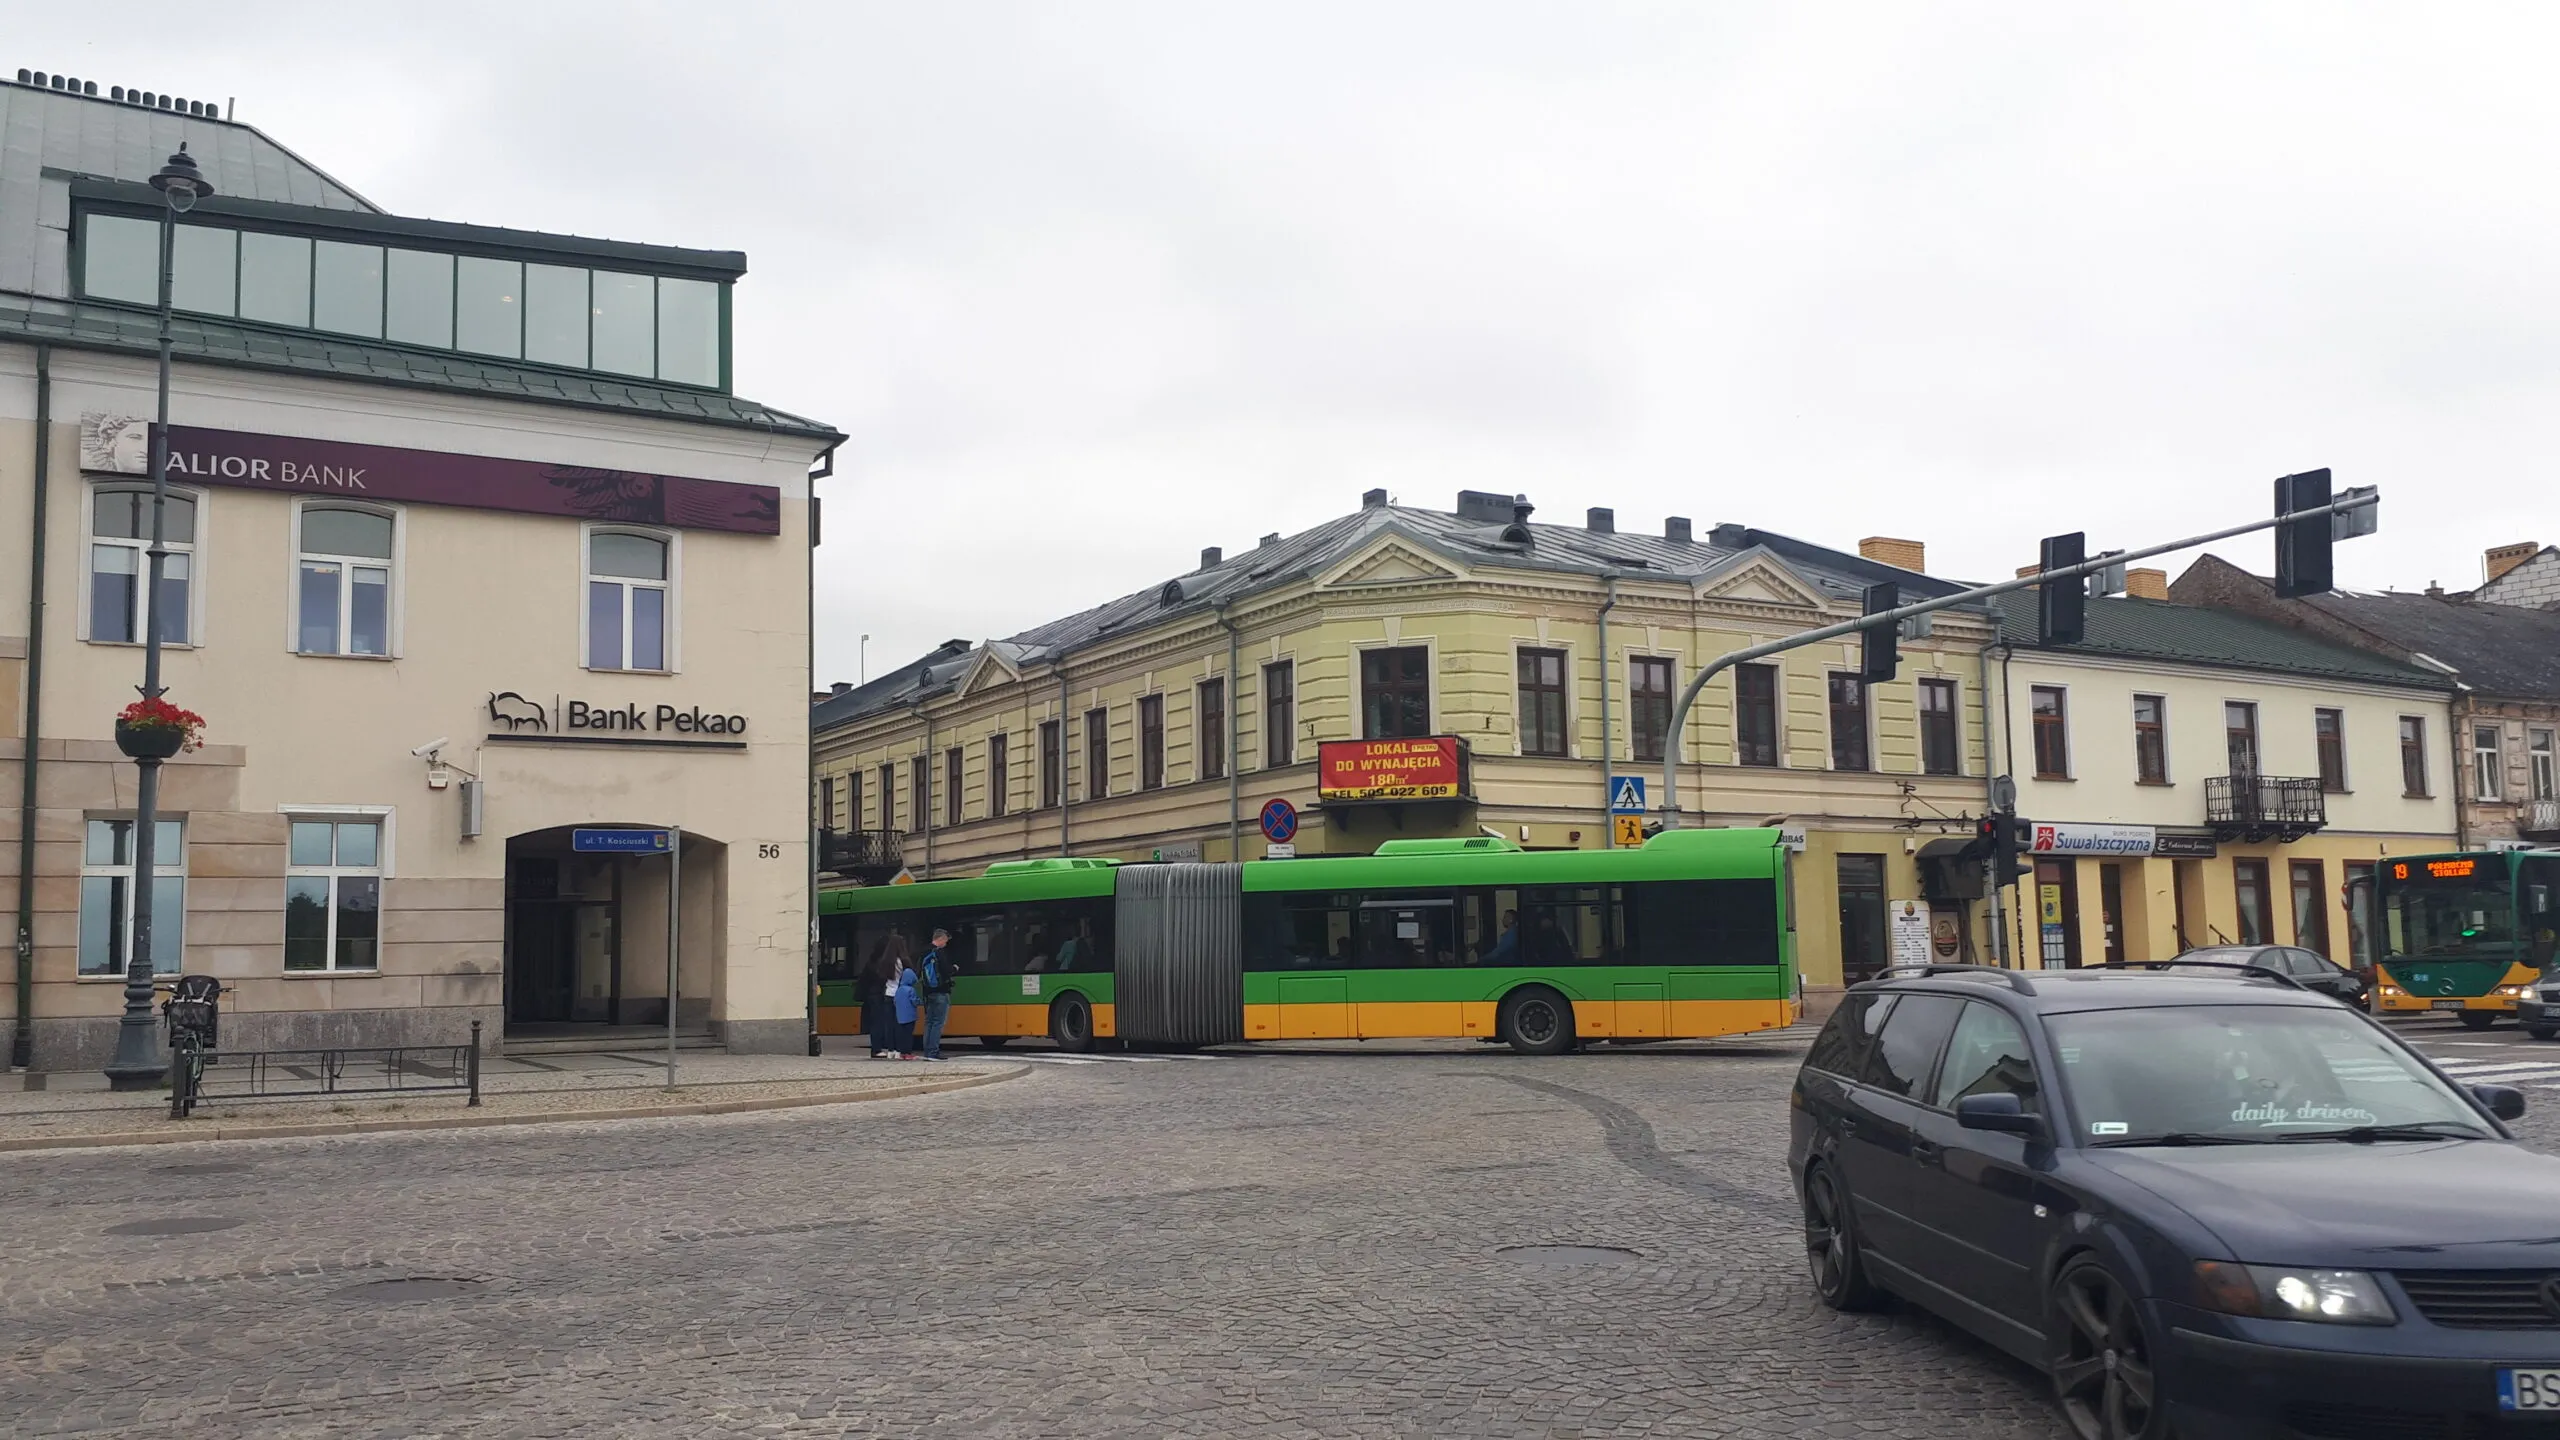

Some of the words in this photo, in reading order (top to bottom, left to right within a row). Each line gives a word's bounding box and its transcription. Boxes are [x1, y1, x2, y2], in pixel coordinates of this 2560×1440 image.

[165, 452, 272, 480] ALIOR
[281, 461, 368, 489] BANK
[568, 700, 647, 731] Bank
[656, 704, 747, 734] Pekao
[1366, 743, 1410, 755] LOKAL
[1335, 760, 1355, 772] DO
[1360, 756, 1441, 771] WYNAJĘCIA
[1390, 786, 1416, 797] 022
[1421, 785, 1448, 796] 609
[585, 837, 595, 845] ul.
[597, 837, 606, 845] T.
[1781, 835, 1804, 844] RIBAS
[2055, 832, 2151, 855] Suwalszczyzna
[758, 844, 780, 859] 56
[2393, 863, 2408, 880] 19
[2231, 1101, 2289, 1122] daily
[2297, 1099, 2378, 1122] driven
